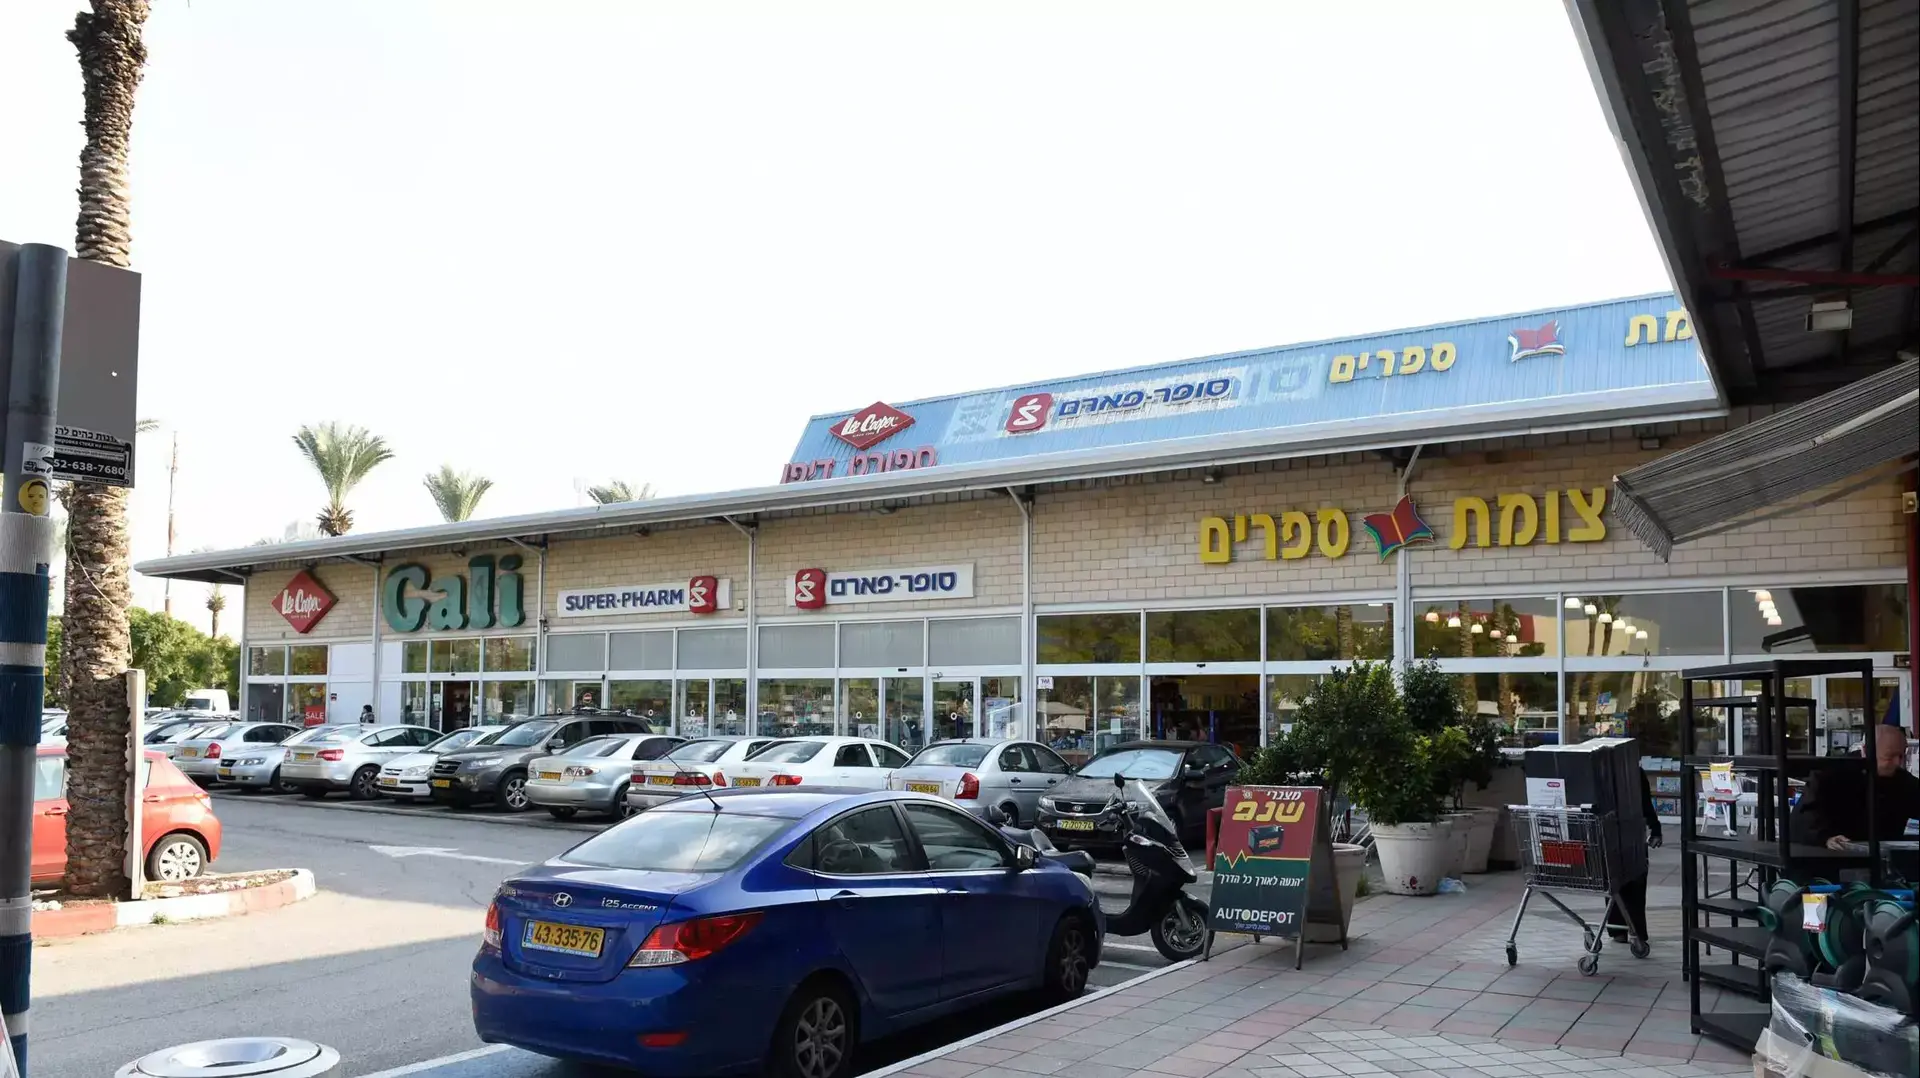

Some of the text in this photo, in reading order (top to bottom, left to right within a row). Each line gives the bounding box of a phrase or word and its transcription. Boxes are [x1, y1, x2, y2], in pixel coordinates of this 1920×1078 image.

[1329, 342, 1457, 384] ספרים
[841, 413, 898, 436] Lee Cooper
[1202, 487, 1607, 564] צומת ספרים
[281, 588, 322, 619] Lee Cooper
[305, 711, 325, 720] SALE
[1266, 790, 1302, 801] מצברי
[1232, 801, 1306, 823] שנפ
[1242, 873, 1253, 884] כל
[1254, 875, 1279, 887] לאורך
[601, 896, 659, 911] i25 ACCENT
[1215, 907, 1295, 924] AUTODEPOT
